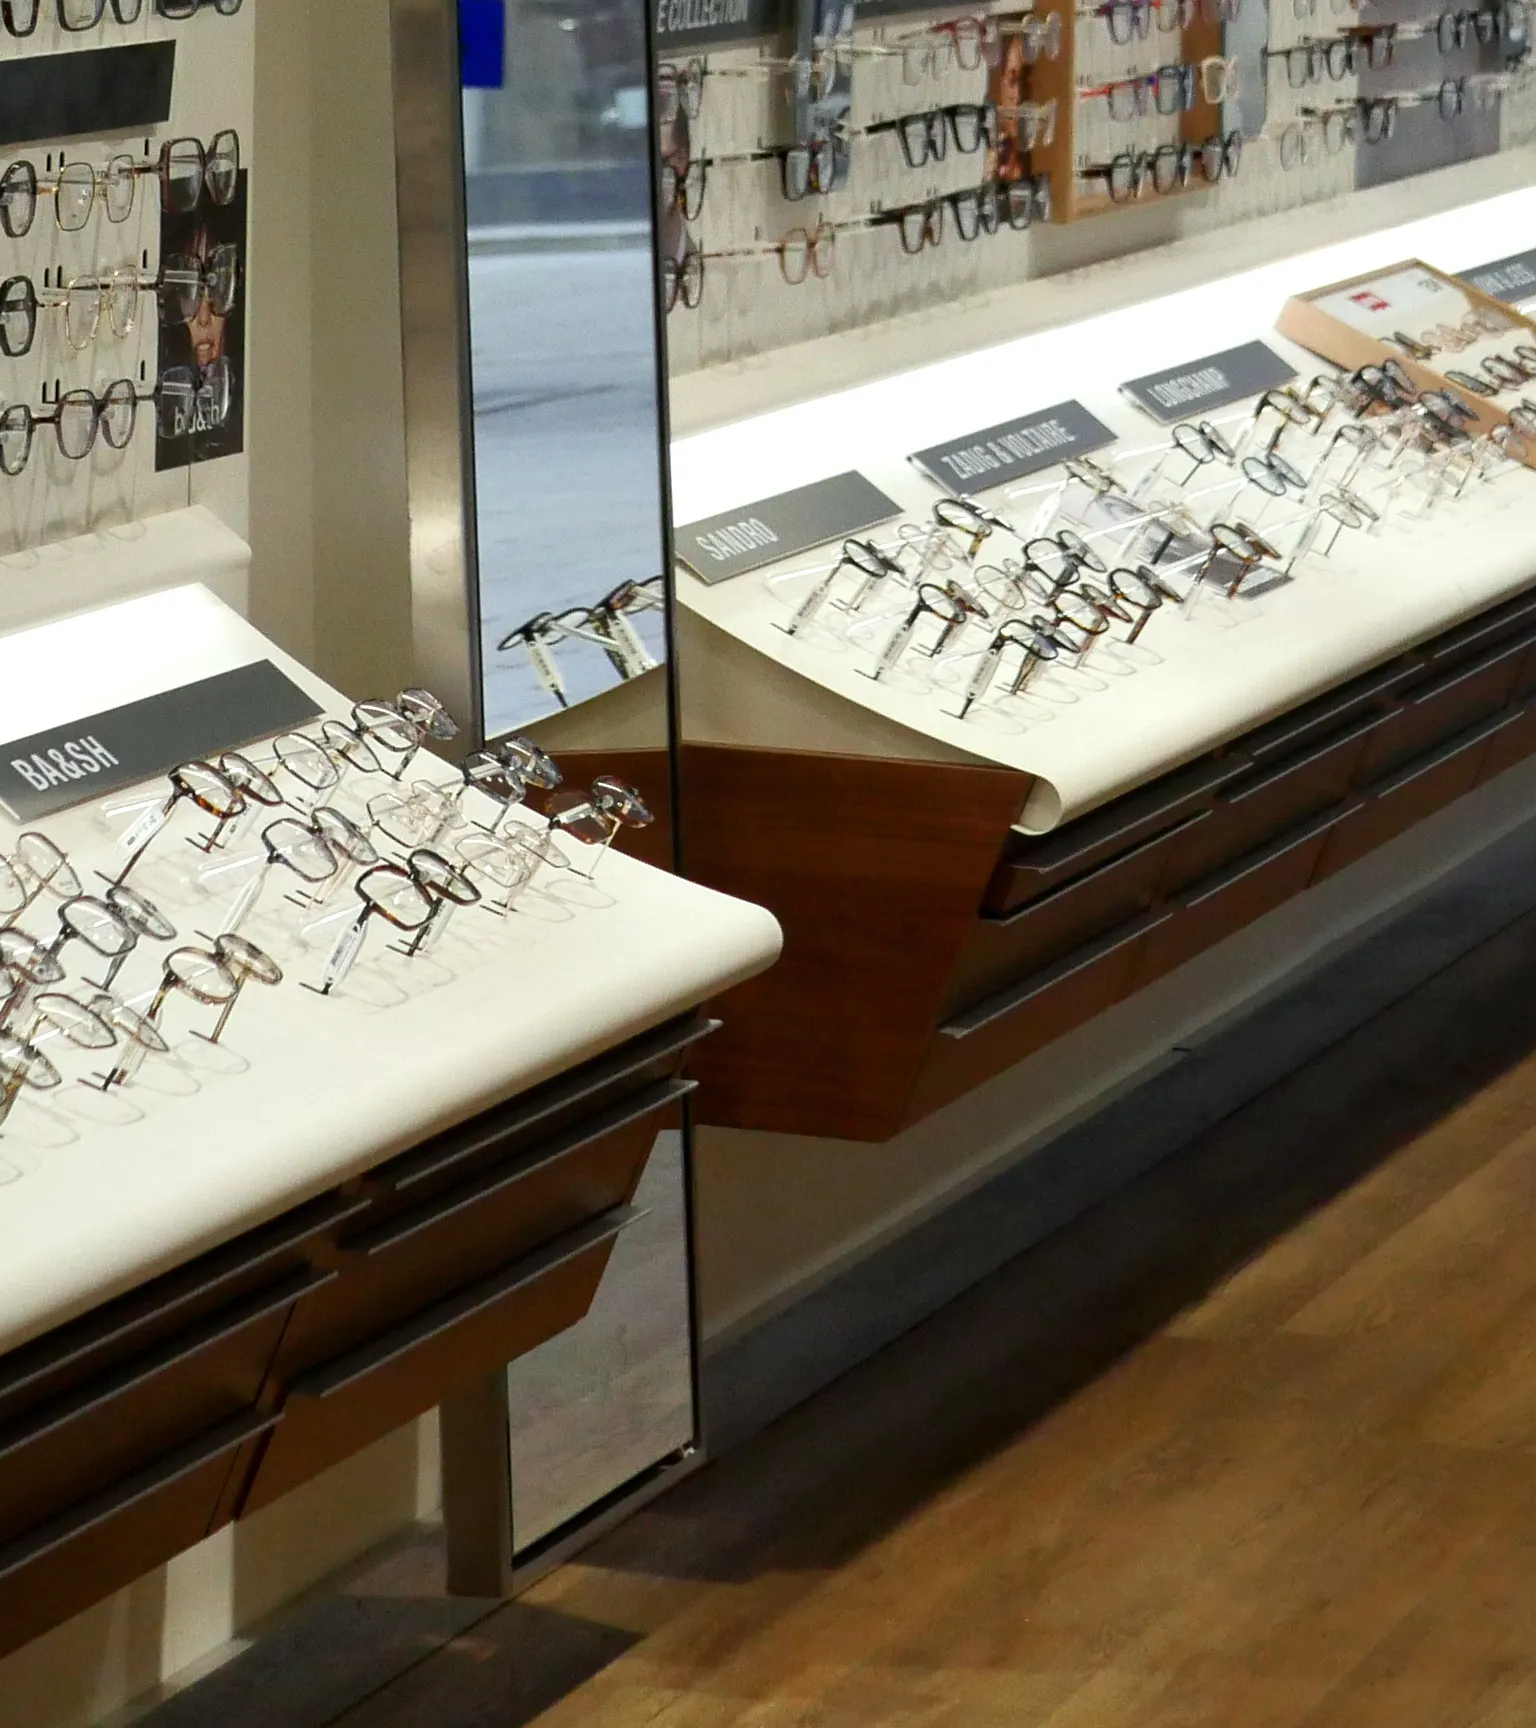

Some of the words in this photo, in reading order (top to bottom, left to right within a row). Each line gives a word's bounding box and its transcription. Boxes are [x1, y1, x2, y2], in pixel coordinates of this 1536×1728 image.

[1145, 366, 1231, 408] LONGCHAMP
[939, 444, 1002, 480] ZADIG
[995, 419, 1076, 459] VOLTAIRE
[695, 517, 779, 561] SANDRO
[10, 735, 120, 792] BA&SH
